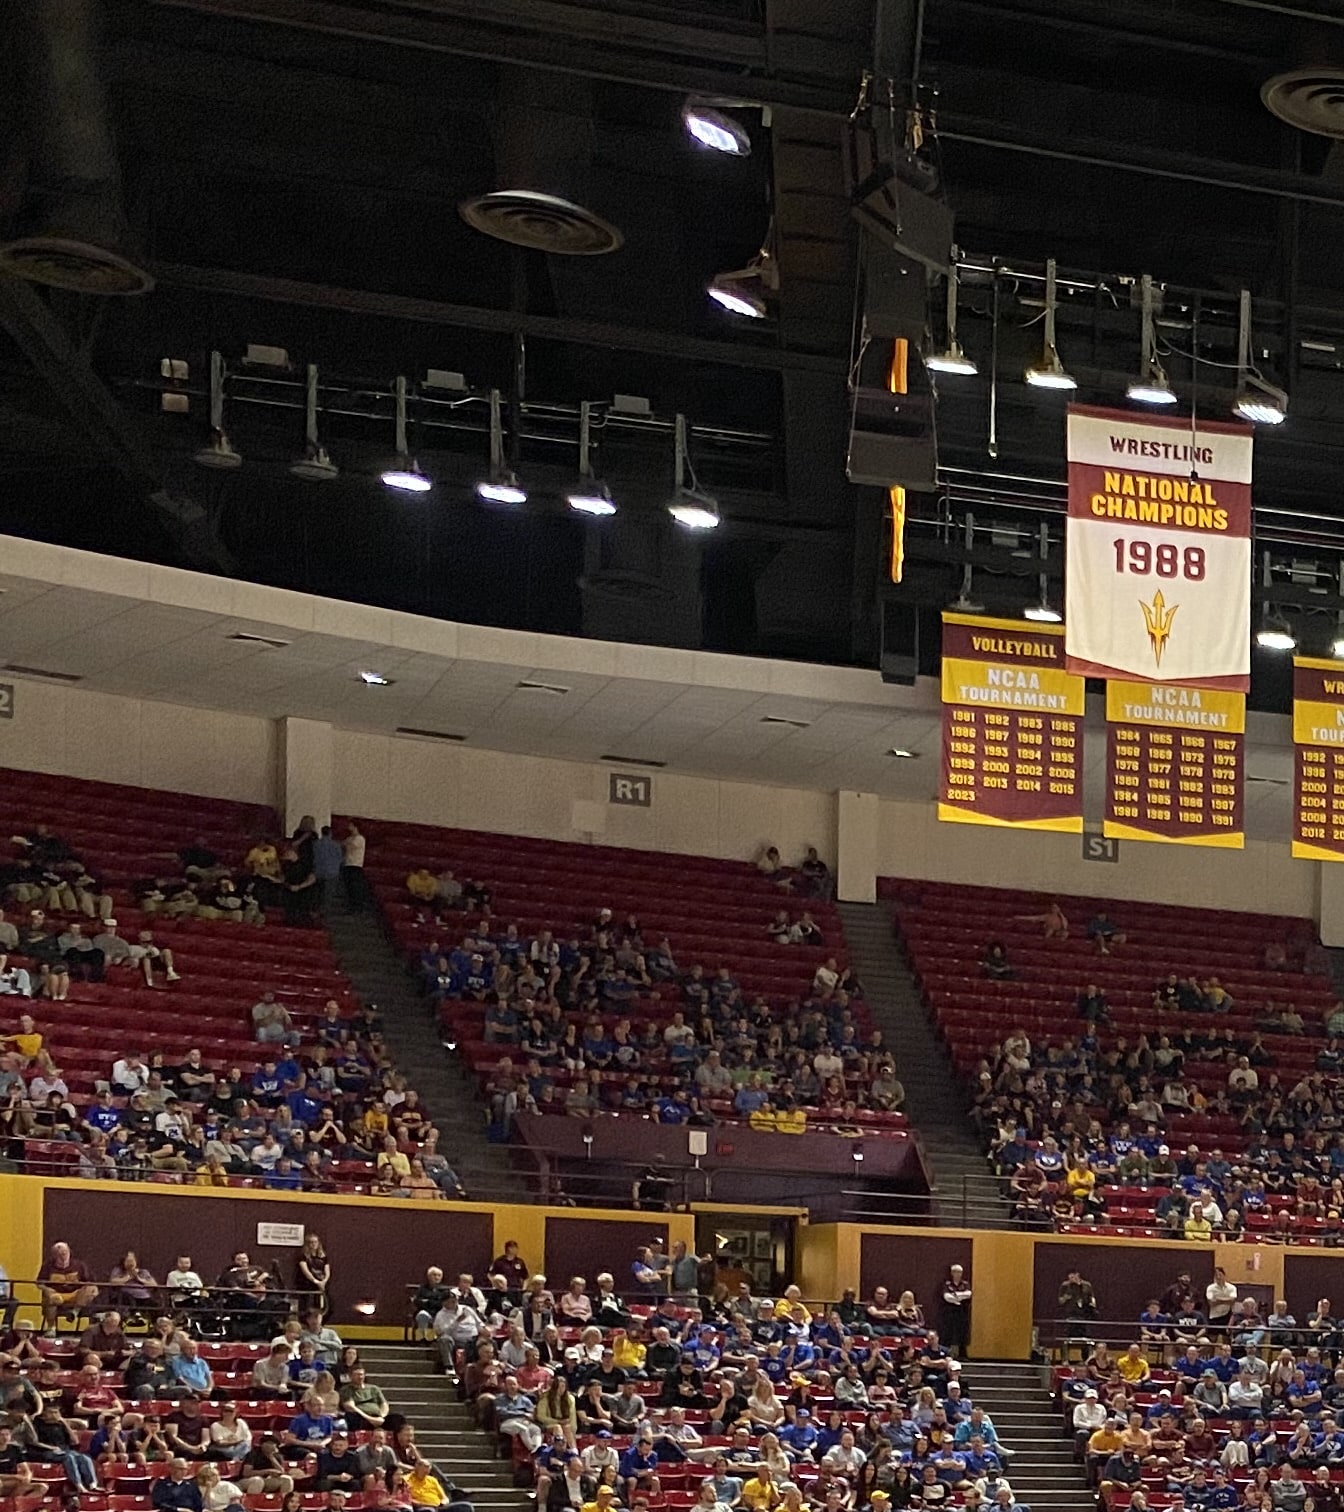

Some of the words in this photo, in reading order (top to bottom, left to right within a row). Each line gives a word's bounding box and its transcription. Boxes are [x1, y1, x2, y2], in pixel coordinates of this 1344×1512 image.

[1110, 436, 1213, 464] WRESTLING
[1104, 471, 1216, 505] NATIONAL
[1091, 495, 1228, 530] CHAMPIONS
[1113, 538, 1205, 581] 1988
[972, 637, 1056, 658] VOLLEYBALL
[988, 669, 1040, 690] NCAA
[960, 686, 1067, 709] TOURNAMENT
[1152, 688, 1201, 707] NCAA
[1125, 704, 1228, 726] TOURNAMENT
[983, 761, 1009, 773] 2000
[1016, 765, 1042, 776] 2002
[616, 779, 645, 800] R1
[950, 774, 974, 785] 2012
[983, 777, 1008, 788] 2013
[1017, 780, 1041, 791] 2014
[1302, 782, 1327, 793] 2000
[948, 790, 975, 800] 2023
[1301, 797, 1326, 808] 2004
[1302, 827, 1325, 838] 2012
[1089, 838, 1113, 857] S1
